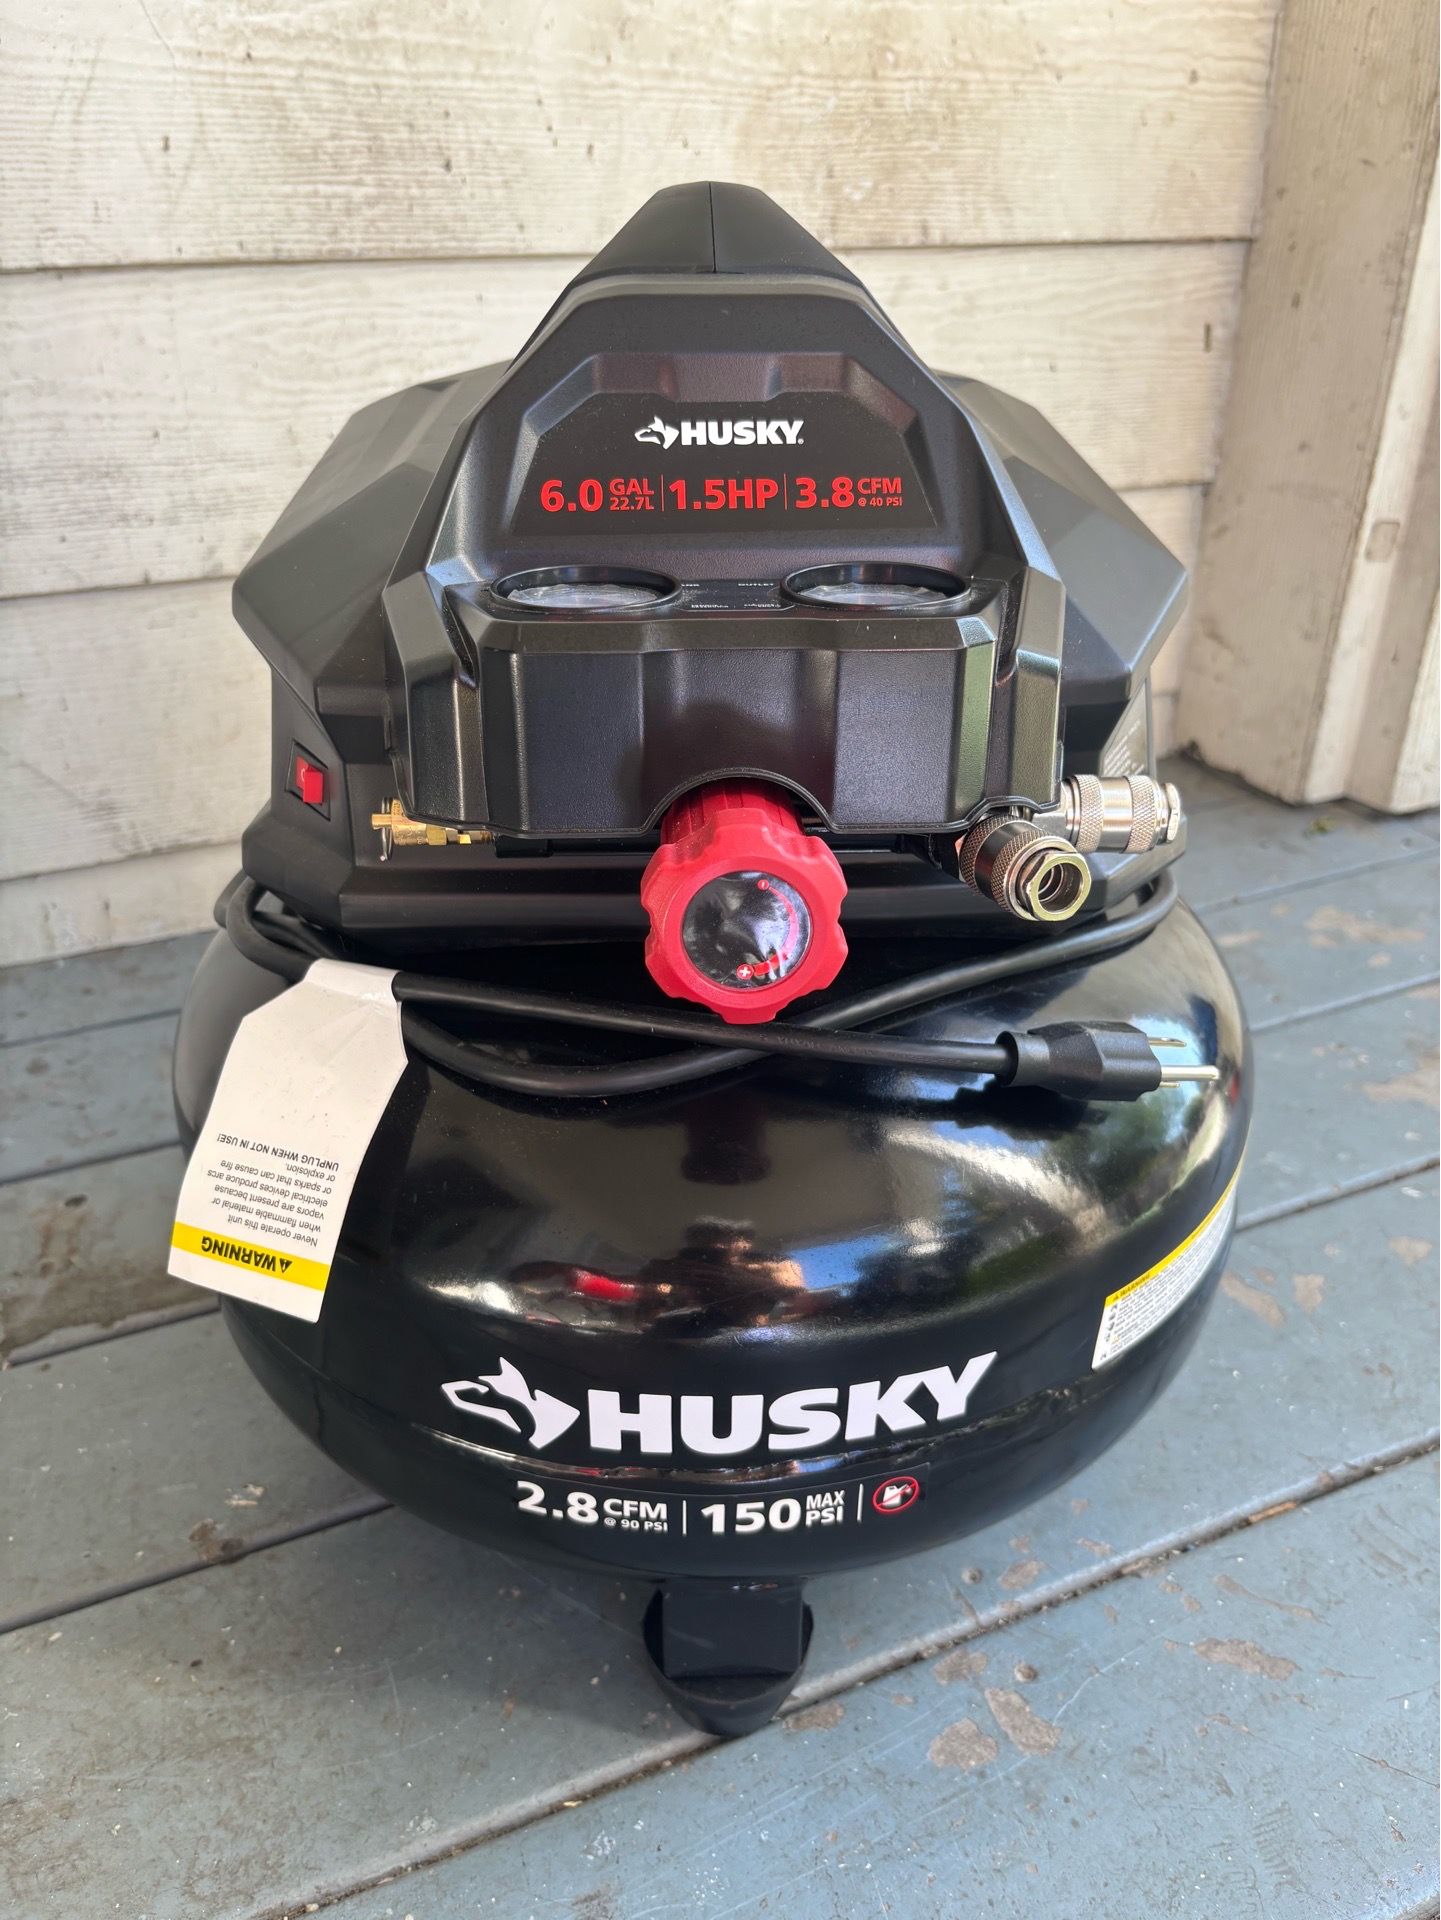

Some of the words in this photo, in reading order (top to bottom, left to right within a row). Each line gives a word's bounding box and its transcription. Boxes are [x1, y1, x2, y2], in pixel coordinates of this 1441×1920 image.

[681, 420, 804, 446] HUSKY
[609, 478, 655, 496] GAL
[795, 476, 855, 509] 3.8
[857, 477, 902, 494] CFM
[540, 479, 604, 512] 6.0
[669, 478, 779, 510] 1.5HP
[609, 497, 655, 511] 22.7L
[858, 497, 867, 508] @
[869, 497, 882, 507] 40
[886, 496, 903, 507] PSI
[216, 1133, 239, 1146] USE!
[239, 1139, 250, 1149] IN
[249, 1141, 270, 1154] NOT
[270, 1147, 299, 1162] WHEN
[220, 1160, 234, 1171] fire
[234, 1163, 259, 1176] cause
[285, 1162, 325, 1179] explosion.
[300, 1154, 339, 1172] UNPLUG
[207, 1169, 224, 1180] arcs
[225, 1174, 259, 1189] produce
[260, 1170, 276, 1180] can
[276, 1174, 292, 1186] that
[326, 1174, 336, 1182] or
[214, 1184, 249, 1201] because
[259, 1183, 290, 1198] devices
[293, 1179, 322, 1192] sparks
[322, 1187, 332, 1195] or
[211, 1197, 221, 1205] or
[221, 1200, 254, 1214] material
[249, 1193, 280, 1208] present
[281, 1202, 295, 1212] are
[291, 1192, 328, 1207] electrical
[227, 1214, 243, 1224] unit
[255, 1209, 297, 1228] flammable
[296, 1206, 325, 1220] vapors
[244, 1219, 259, 1230] this
[260, 1223, 292, 1238] operate
[299, 1221, 321, 1232] when
[292, 1233, 318, 1247] Never
[202, 1236, 277, 1272] WARNING
[588, 1351, 997, 1454] HUSKY
[517, 1480, 599, 1524] 2.8
[806, 1490, 845, 1509] MAX
[603, 1498, 667, 1520] CFM
[701, 1499, 801, 1534] 150
[806, 1506, 843, 1527] PSI
[604, 1517, 616, 1527] @
[621, 1519, 640, 1531] 90
[644, 1521, 668, 1533] PSI
